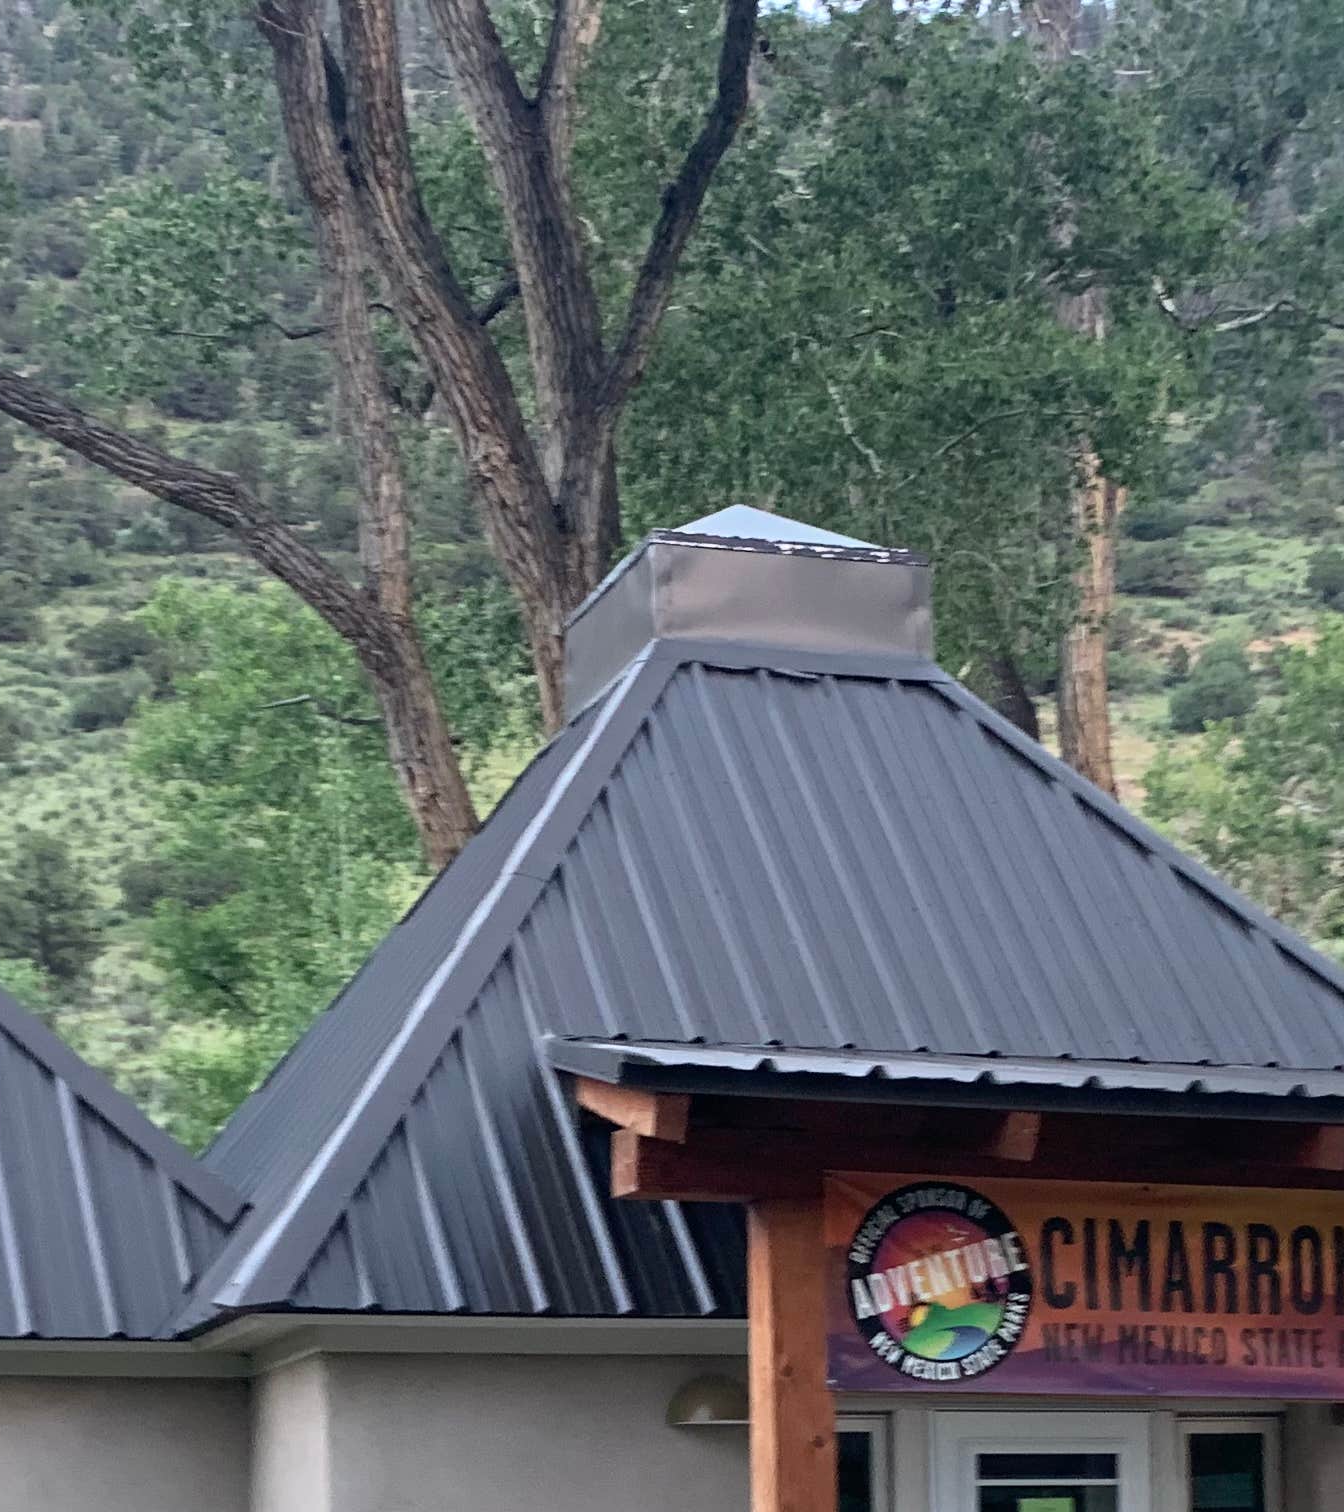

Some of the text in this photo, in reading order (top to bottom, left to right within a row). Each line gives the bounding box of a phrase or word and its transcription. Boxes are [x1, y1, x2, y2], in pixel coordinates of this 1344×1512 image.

[850, 1231, 1030, 1320] ADVENTURE
[1043, 1323, 1106, 1364] NEW
[1117, 1324, 1229, 1366] MEXICO
[1240, 1327, 1325, 1369] STATE
